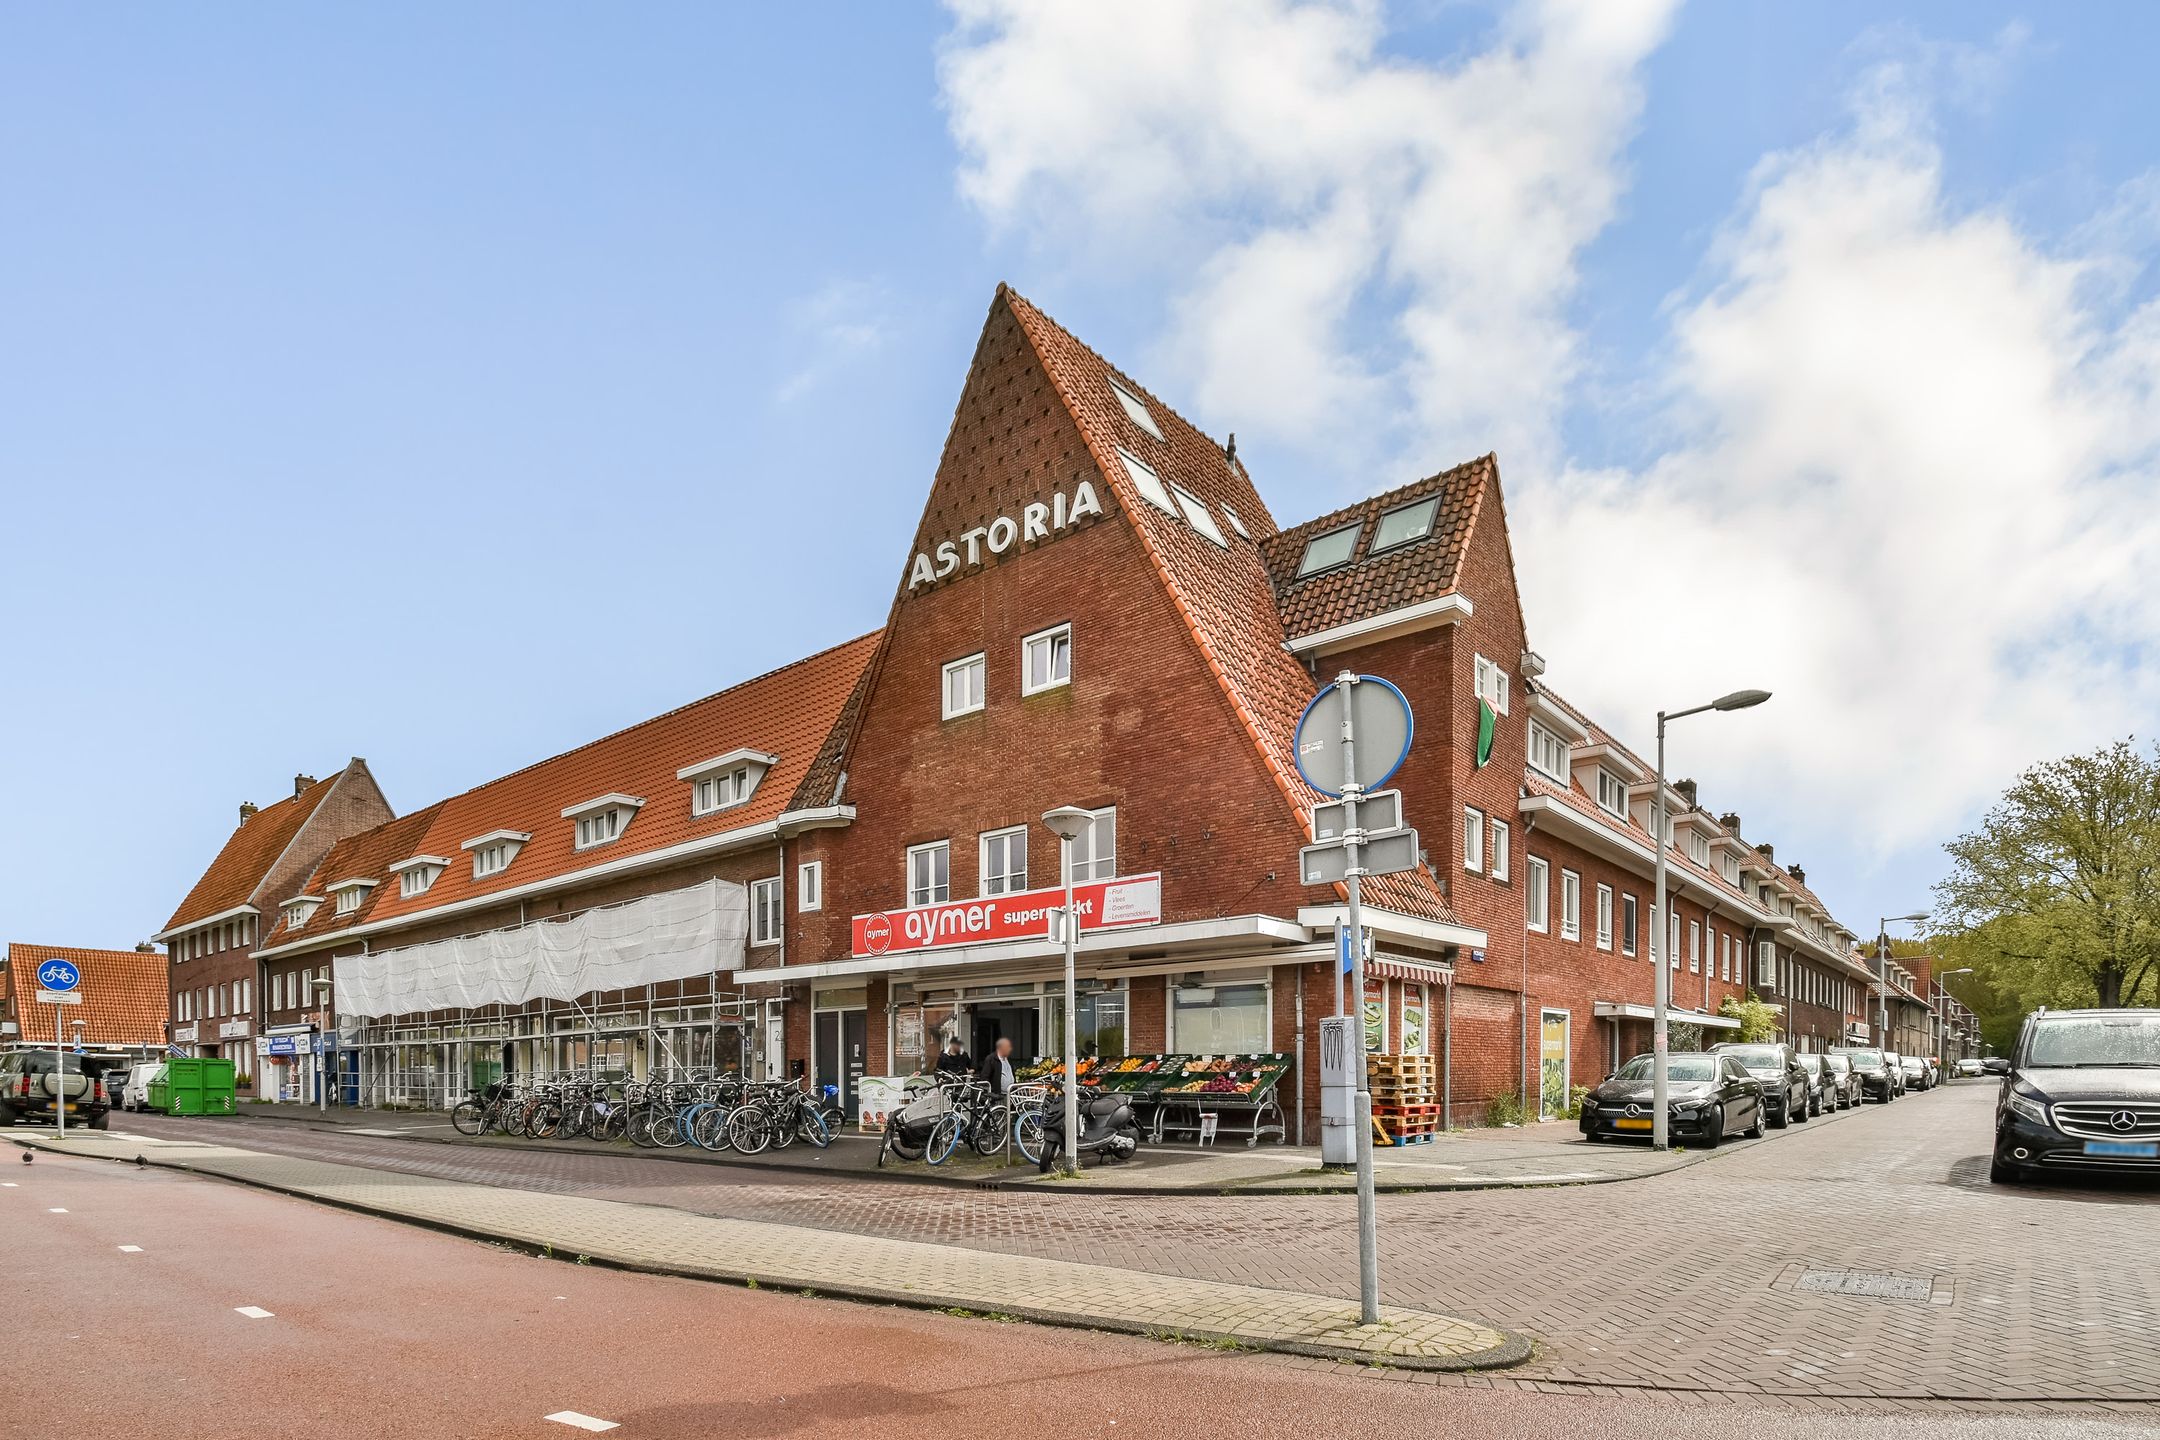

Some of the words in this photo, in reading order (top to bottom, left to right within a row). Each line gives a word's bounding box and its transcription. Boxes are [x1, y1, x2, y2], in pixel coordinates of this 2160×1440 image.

[908, 481, 1103, 591] ASTORIA
[867, 927, 890, 940] aymer
[904, 903, 996, 945] aymer
